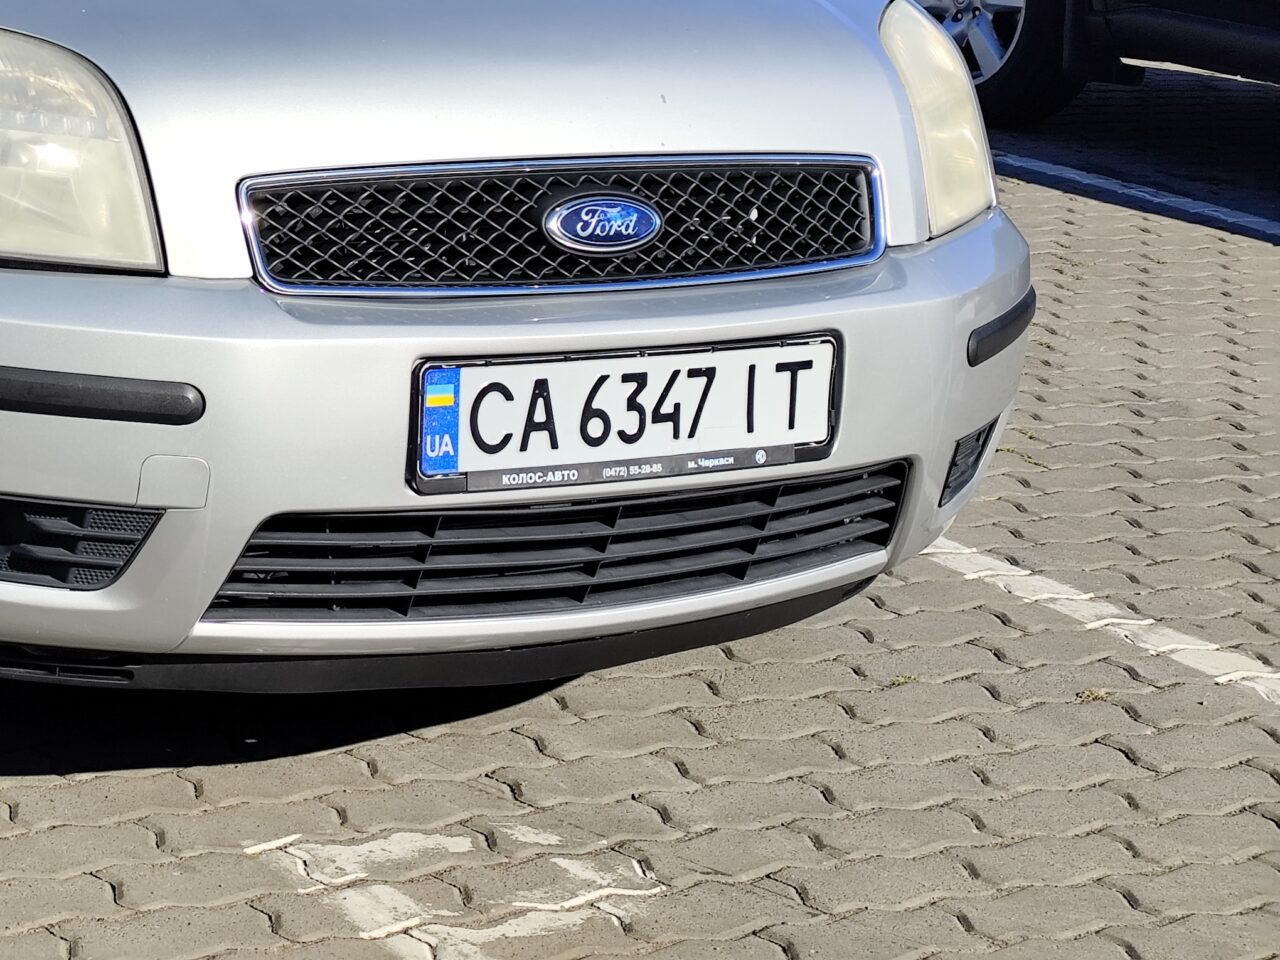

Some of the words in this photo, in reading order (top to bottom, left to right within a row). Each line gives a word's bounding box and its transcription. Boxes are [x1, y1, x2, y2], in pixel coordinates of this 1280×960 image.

[576, 206, 639, 237] Ford
[469, 378, 559, 454] CA
[579, 367, 716, 447] 6347
[747, 360, 813, 434] IT
[426, 434, 455, 458] UA
[502, 469, 579, 485] КОЛОС-АВТО
[603, 466, 628, 479] (0472)
[698, 456, 734, 468] Черкаси
